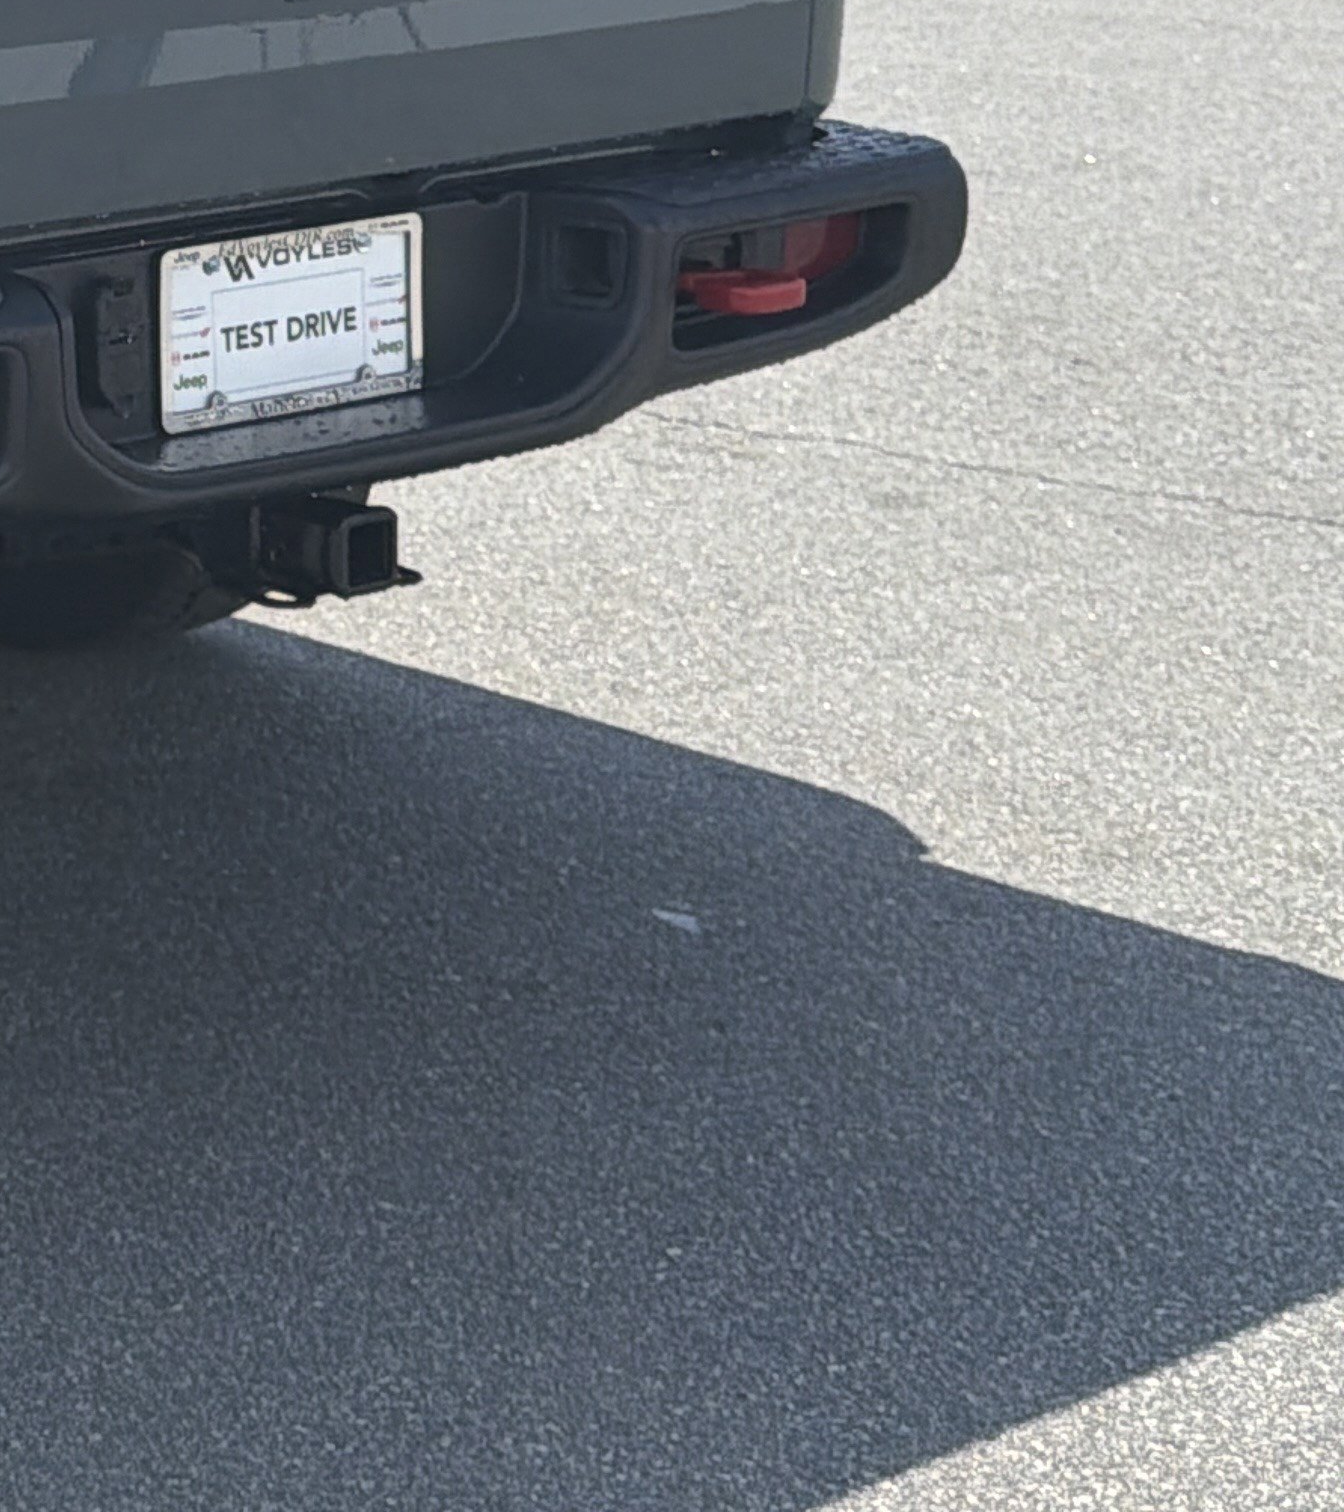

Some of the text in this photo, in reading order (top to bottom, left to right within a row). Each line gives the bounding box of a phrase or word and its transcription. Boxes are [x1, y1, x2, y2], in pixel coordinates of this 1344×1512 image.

[255, 239, 354, 269] VOYLES
[220, 306, 358, 353] TEST DRIVE
[372, 339, 404, 356] Jeep
[173, 374, 208, 391] Jeep
